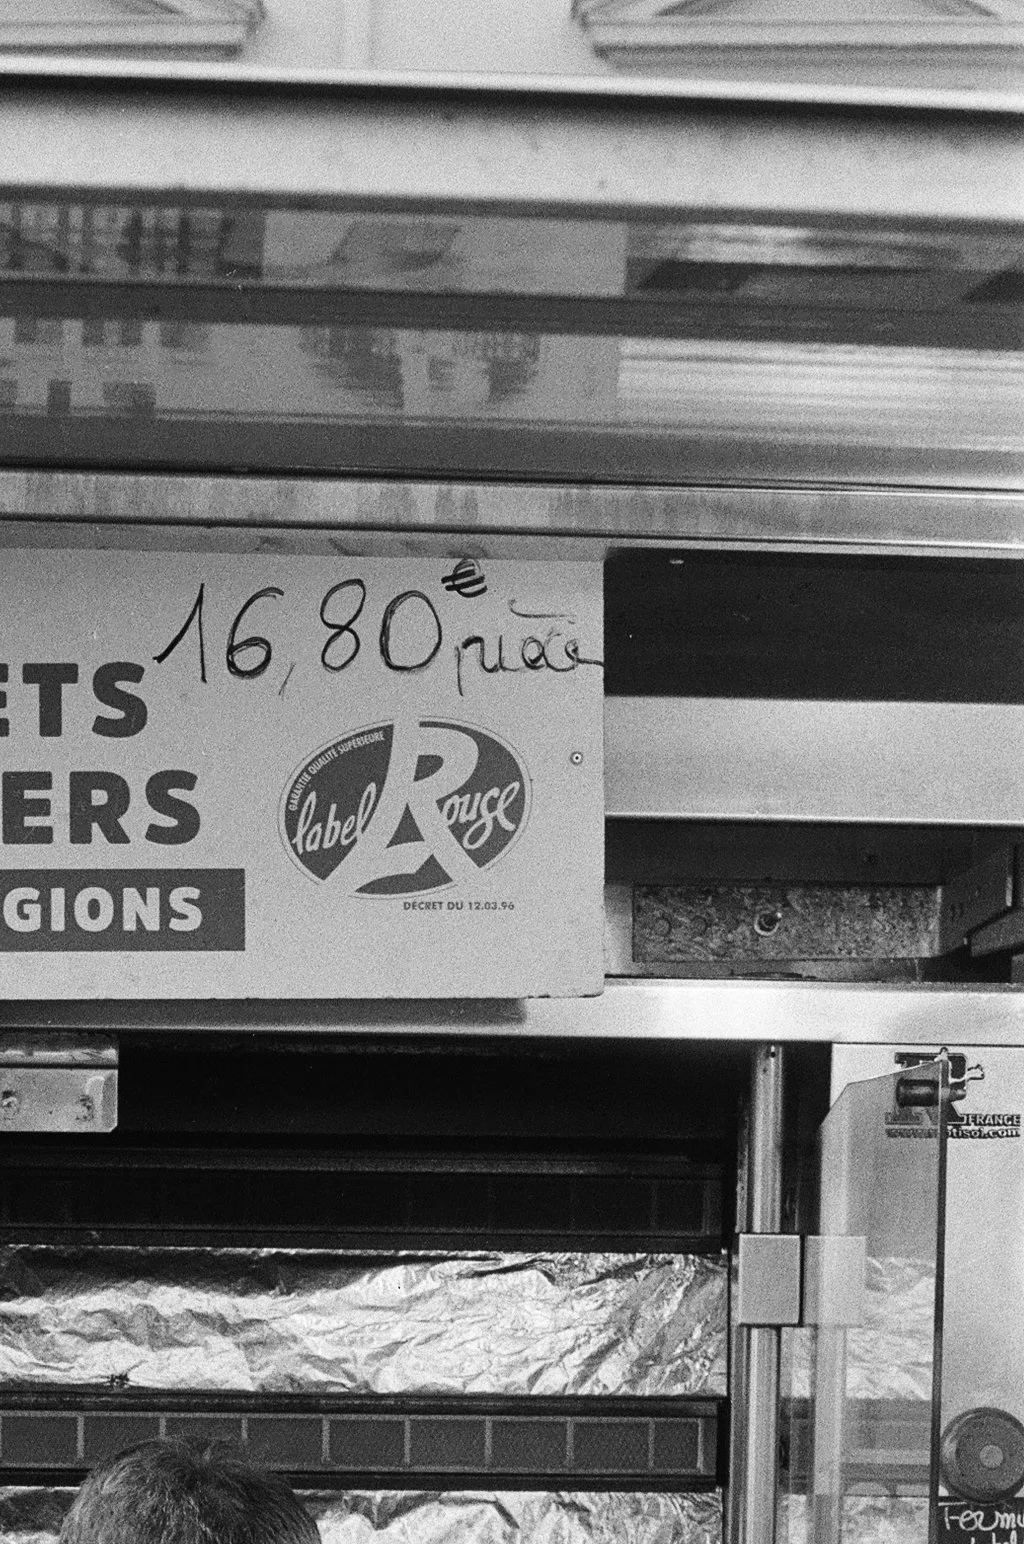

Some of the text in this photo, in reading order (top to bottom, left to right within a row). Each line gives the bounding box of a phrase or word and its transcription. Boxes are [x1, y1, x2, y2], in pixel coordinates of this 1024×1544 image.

[287, 773, 312, 811] GARANTIE
[446, 900, 465, 912] DU
[468, 900, 515, 912] 12.03.96
